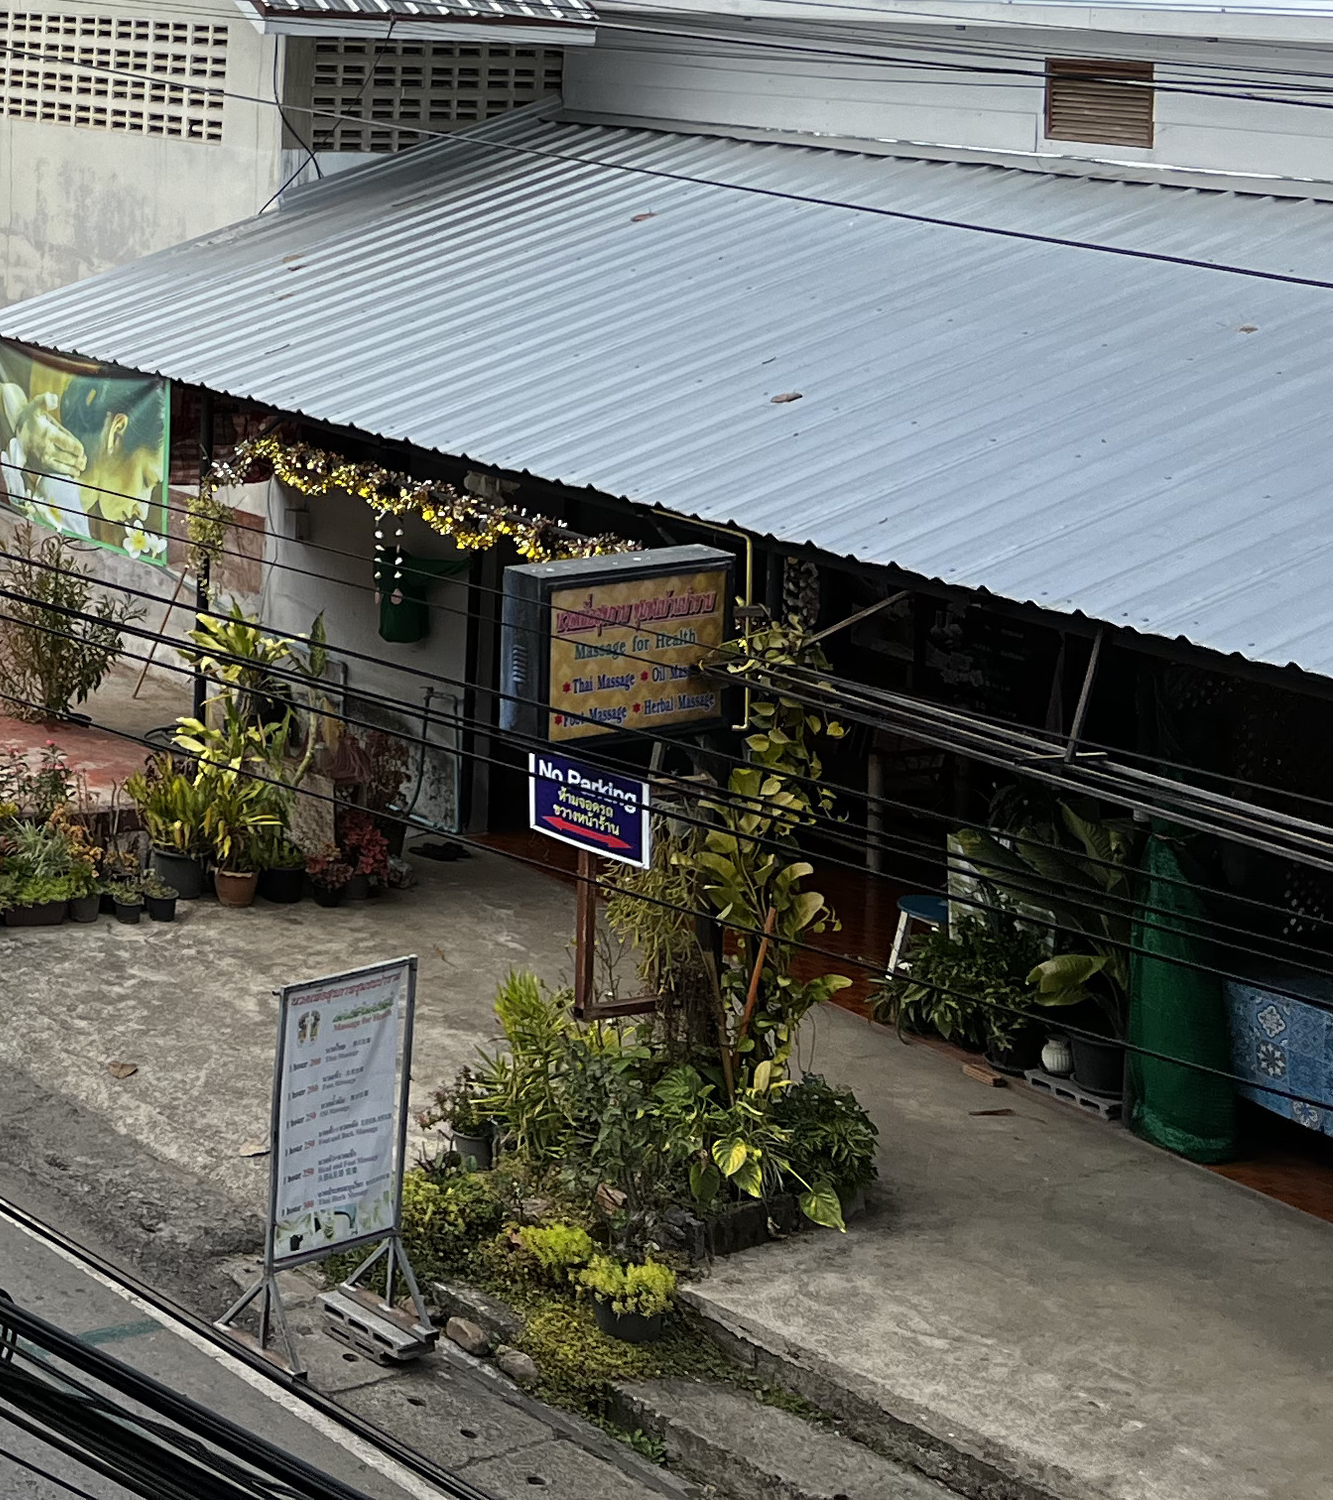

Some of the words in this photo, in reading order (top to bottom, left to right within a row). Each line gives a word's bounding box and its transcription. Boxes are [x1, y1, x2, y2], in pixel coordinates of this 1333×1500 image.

[574, 640, 626, 660] Massage
[632, 635, 650, 652] for
[656, 629, 696, 649] Health
[573, 678, 593, 694] Thai
[597, 673, 635, 691] Massage
[652, 665, 665, 682] Oil
[589, 706, 627, 724] Massage
[643, 697, 674, 715] Herbal
[678, 693, 714, 710] Massage
[538, 759, 564, 781] No
[567, 769, 637, 814] Parking
[558, 786, 614, 818] ห้ามจอดรถ
